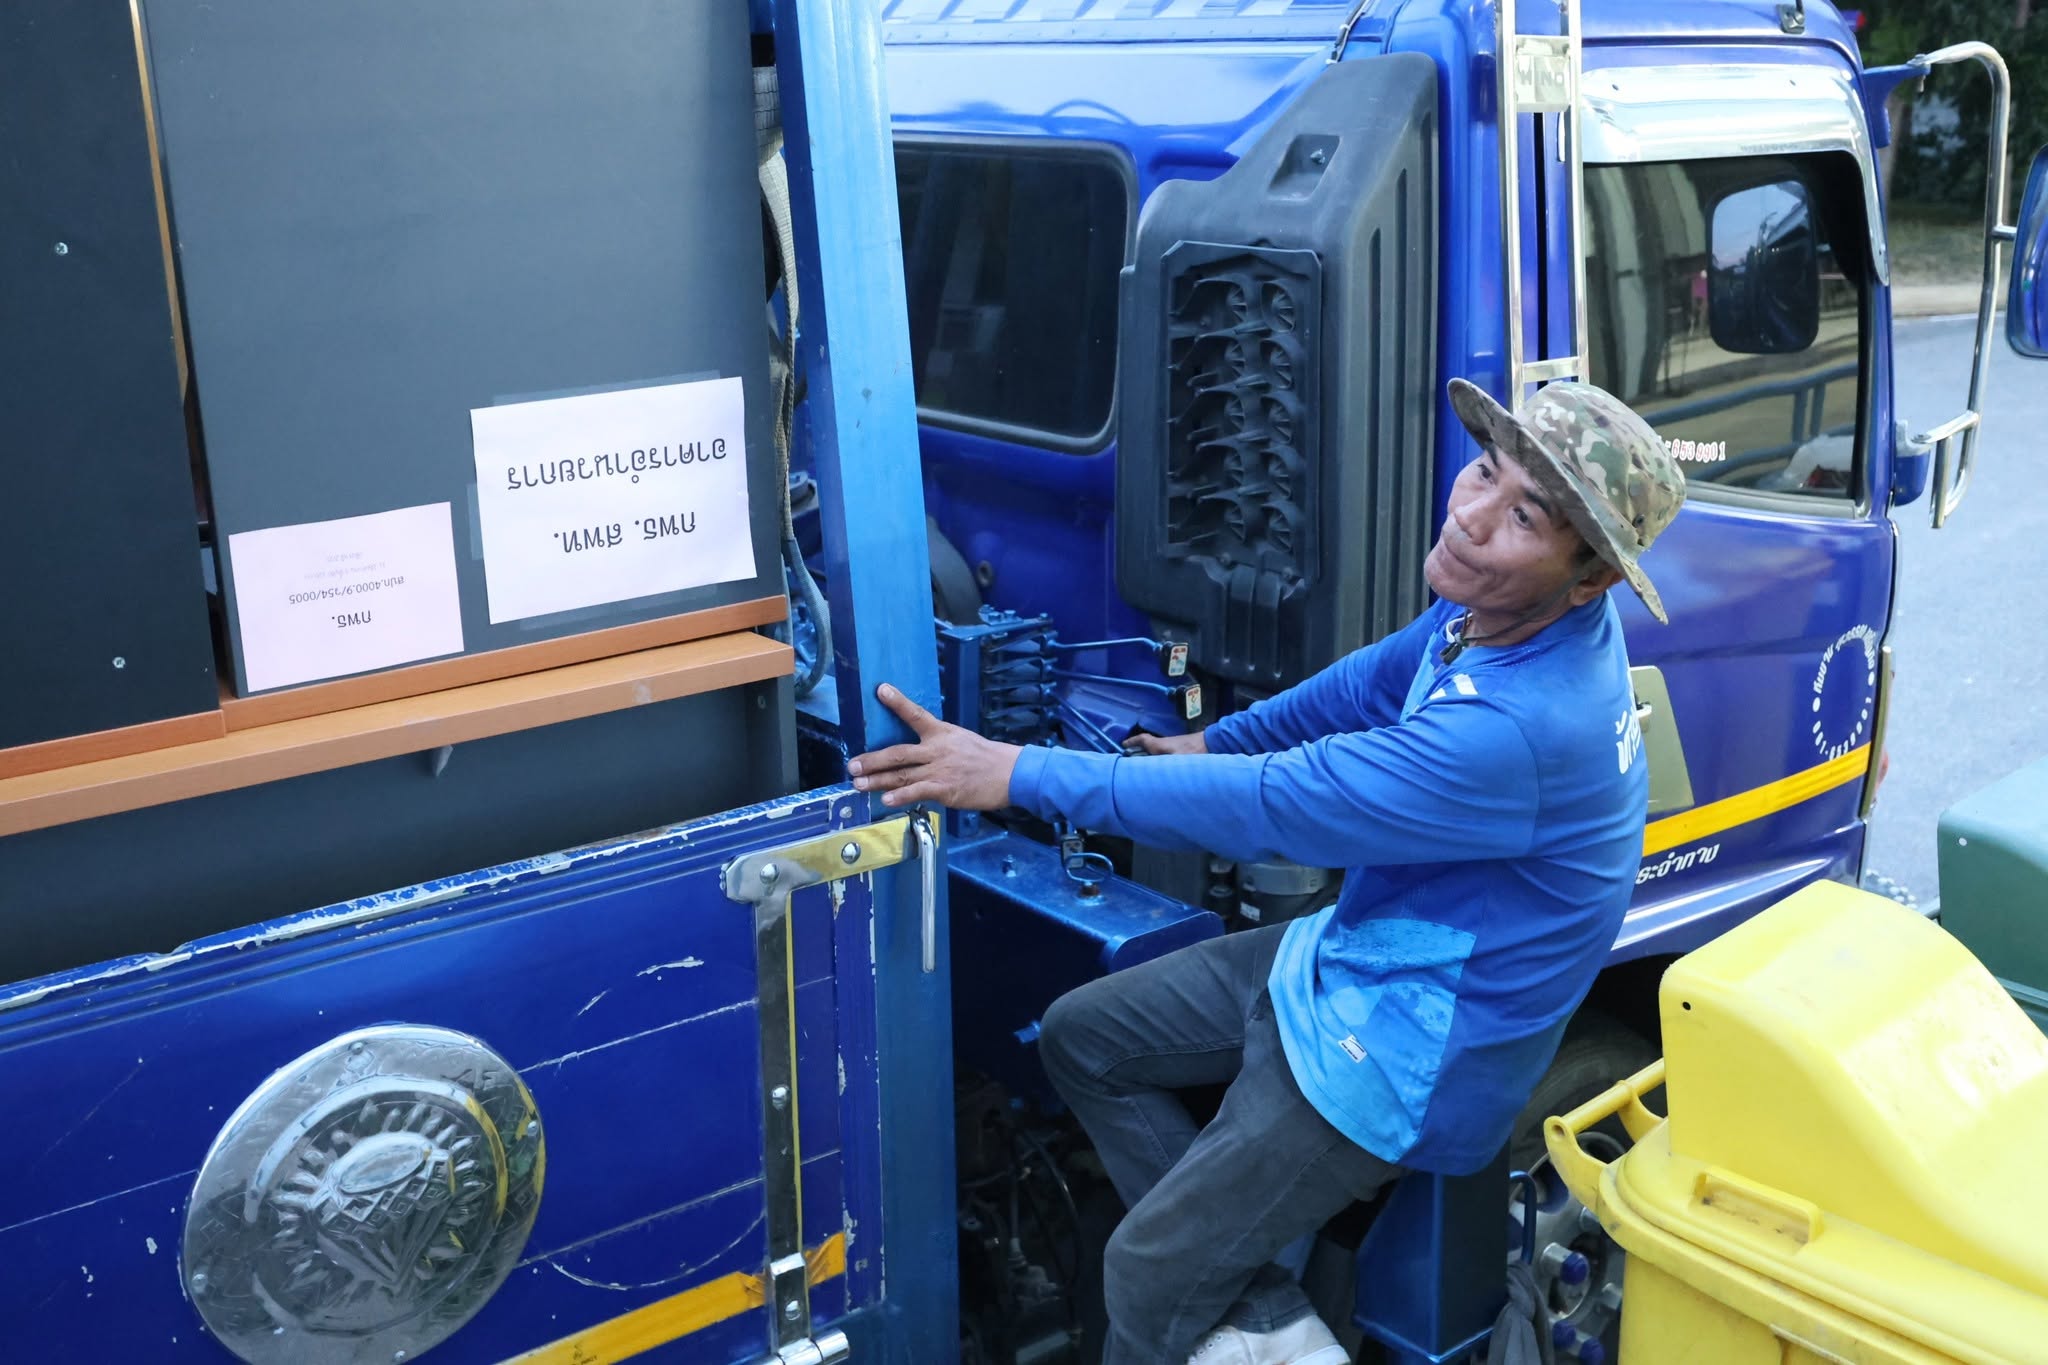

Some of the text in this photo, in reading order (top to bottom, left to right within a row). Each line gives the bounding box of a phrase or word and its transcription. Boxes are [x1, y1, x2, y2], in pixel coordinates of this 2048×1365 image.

[507, 437, 728, 491] อาคารอำนวยการ
[1664, 438, 1727, 464] -6539901
[553, 511, 697, 554] กพธ. สพท.
[331, 608, 373, 629] กพธ.
[1634, 843, 1721, 886] ระจำทาง
